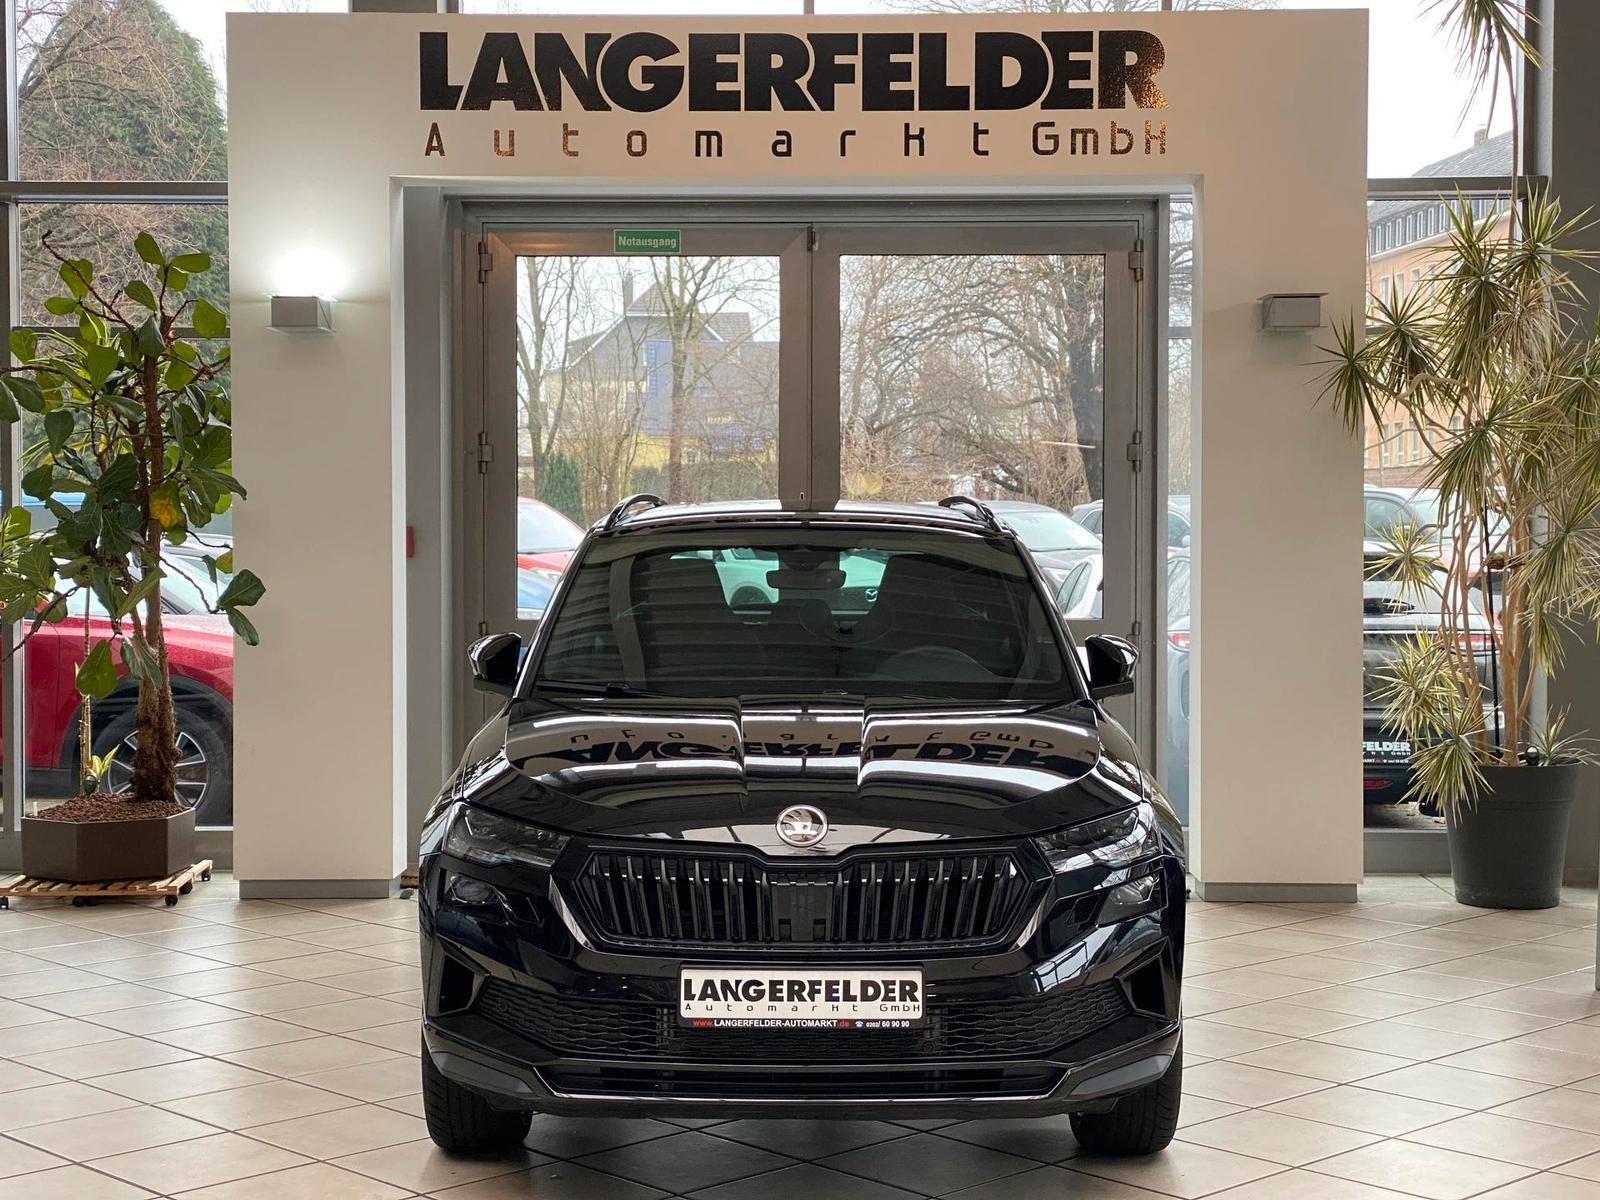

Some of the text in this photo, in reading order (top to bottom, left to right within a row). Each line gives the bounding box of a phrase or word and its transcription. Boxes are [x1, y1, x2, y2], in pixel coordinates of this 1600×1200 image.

[420, 30, 1168, 112] LANGERFELDER
[424, 120, 1167, 158] Automarkt GmbH
[618, 236, 677, 248] Notausgang
[684, 979, 920, 1002] LANGERFELDER
[880, 1003, 920, 1012] GmbH
